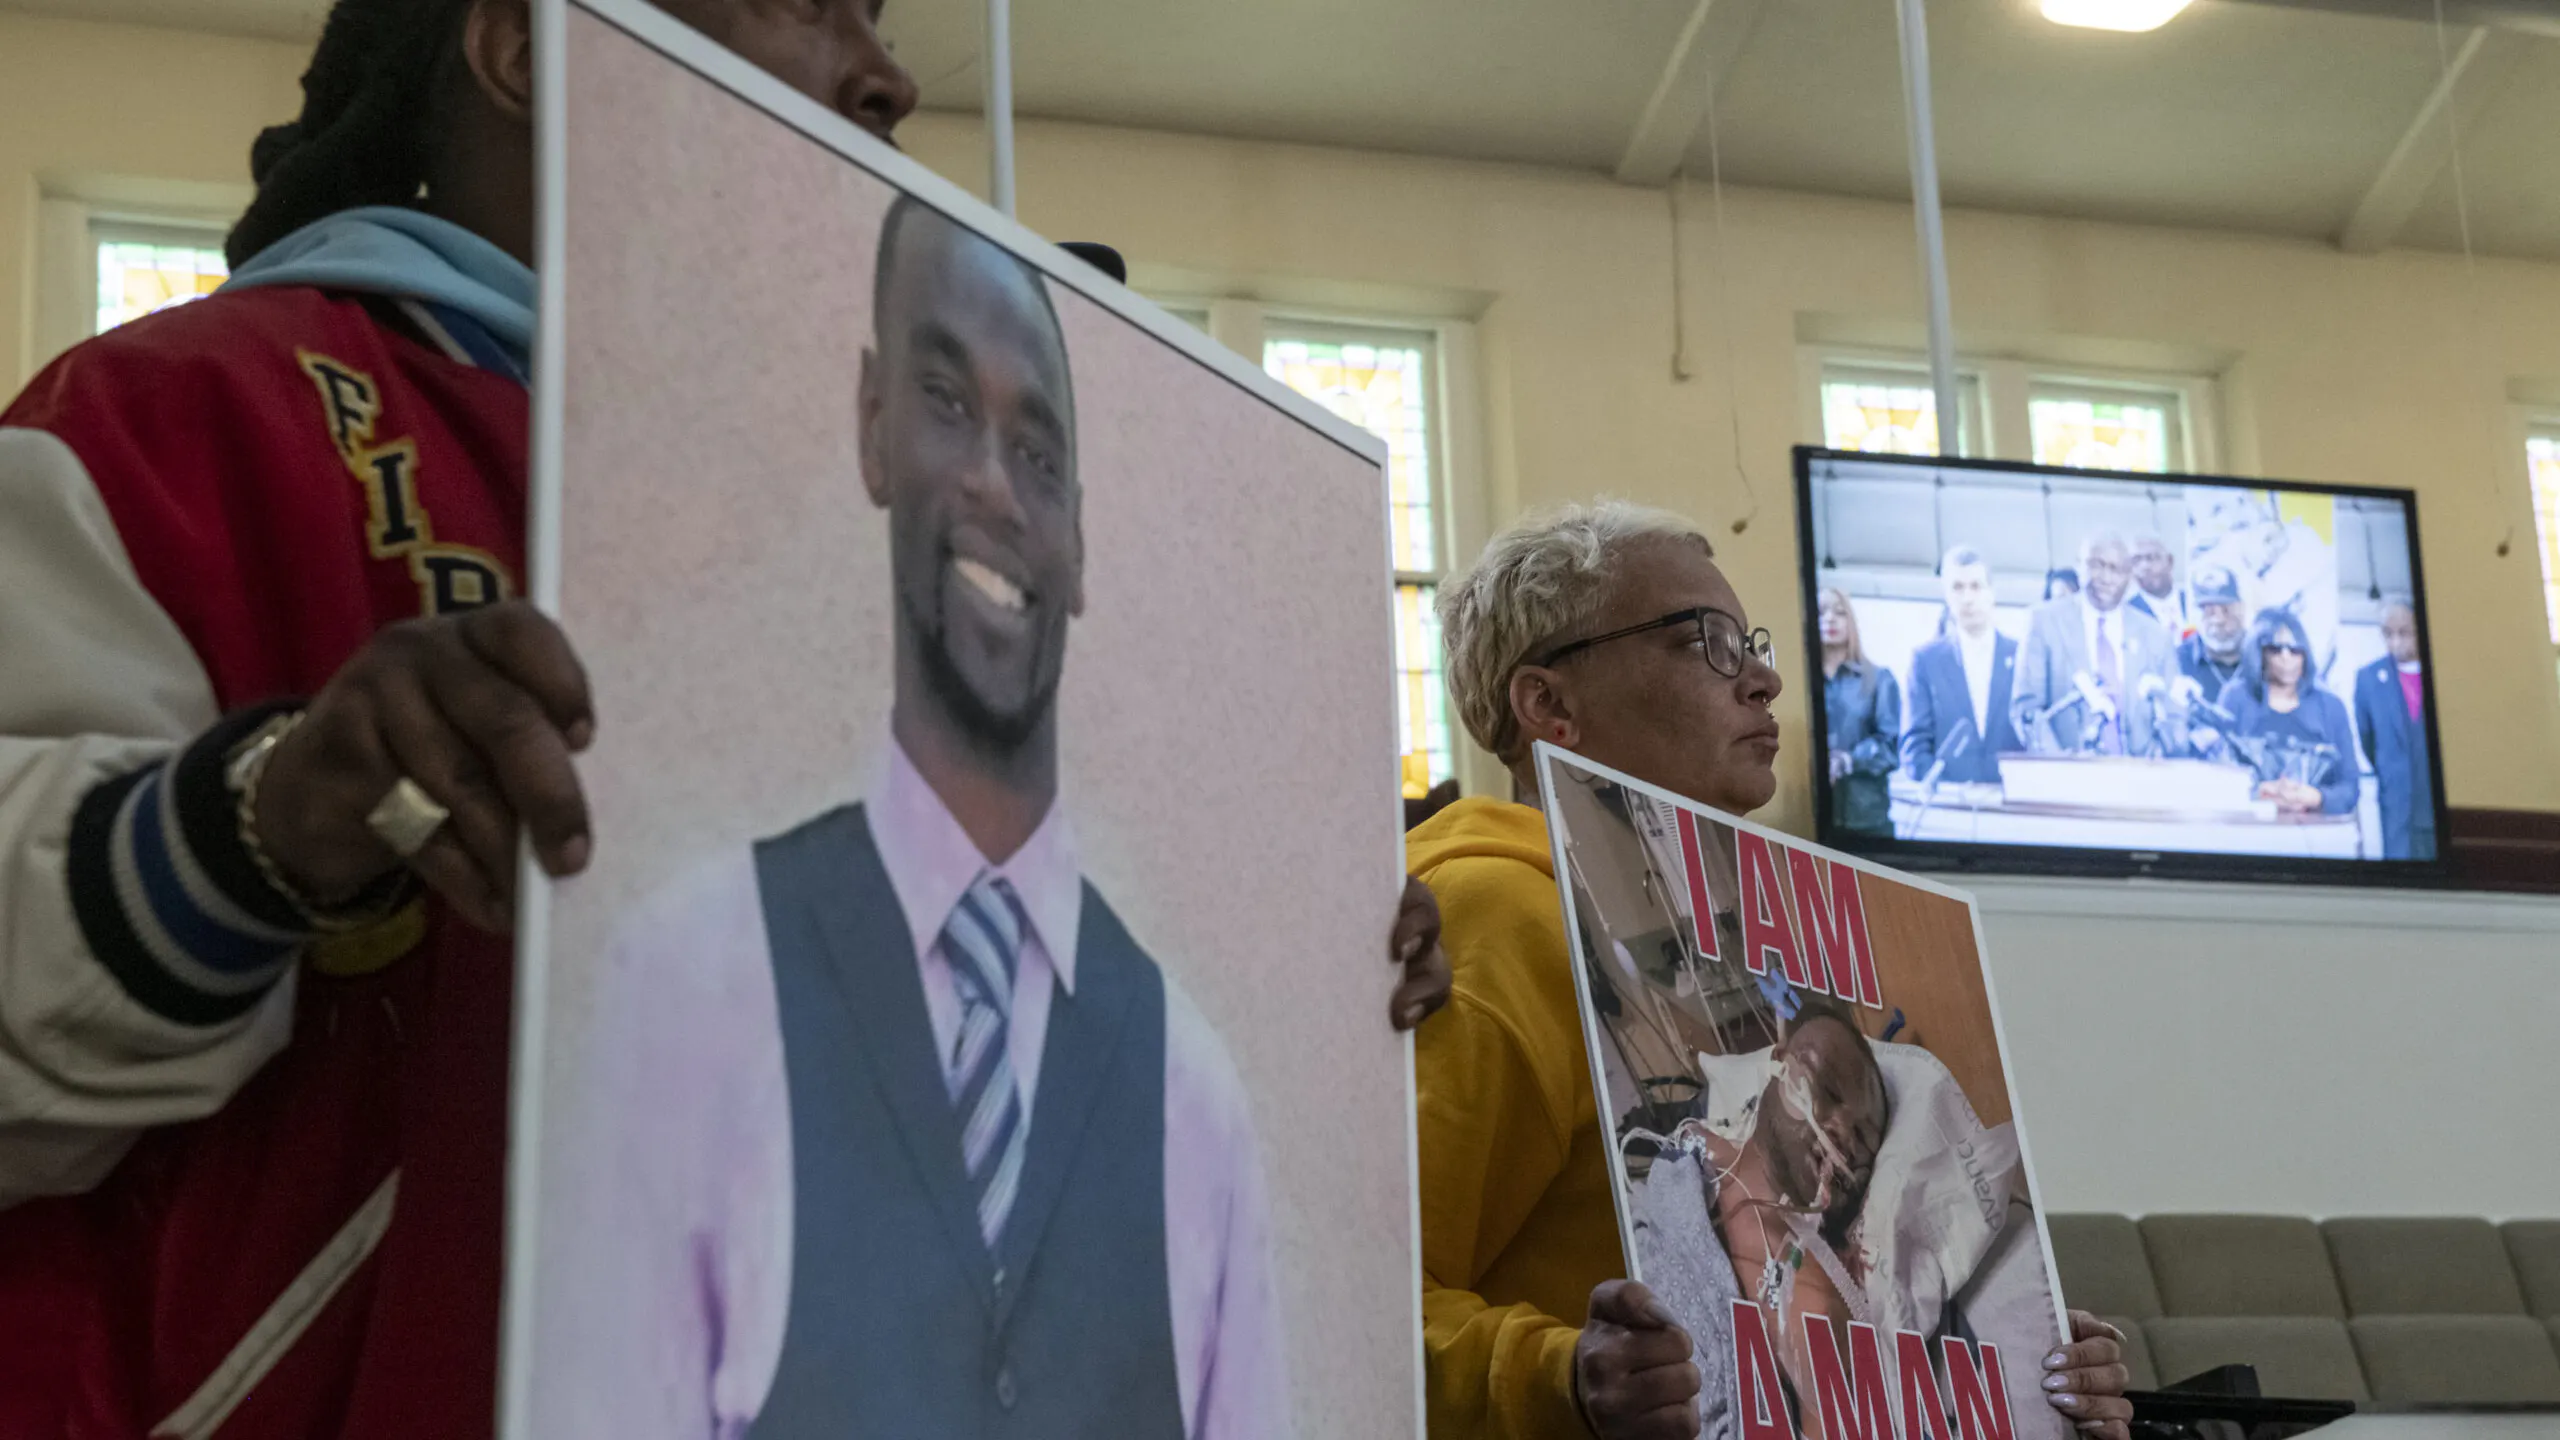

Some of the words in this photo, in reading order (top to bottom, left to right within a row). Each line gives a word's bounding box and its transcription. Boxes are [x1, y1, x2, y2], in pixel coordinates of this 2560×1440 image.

[1674, 805, 1721, 962] I
[1735, 827, 1883, 1010] AM
[1730, 1299, 1799, 1440] A
[1802, 1312, 2017, 1440] MAN
